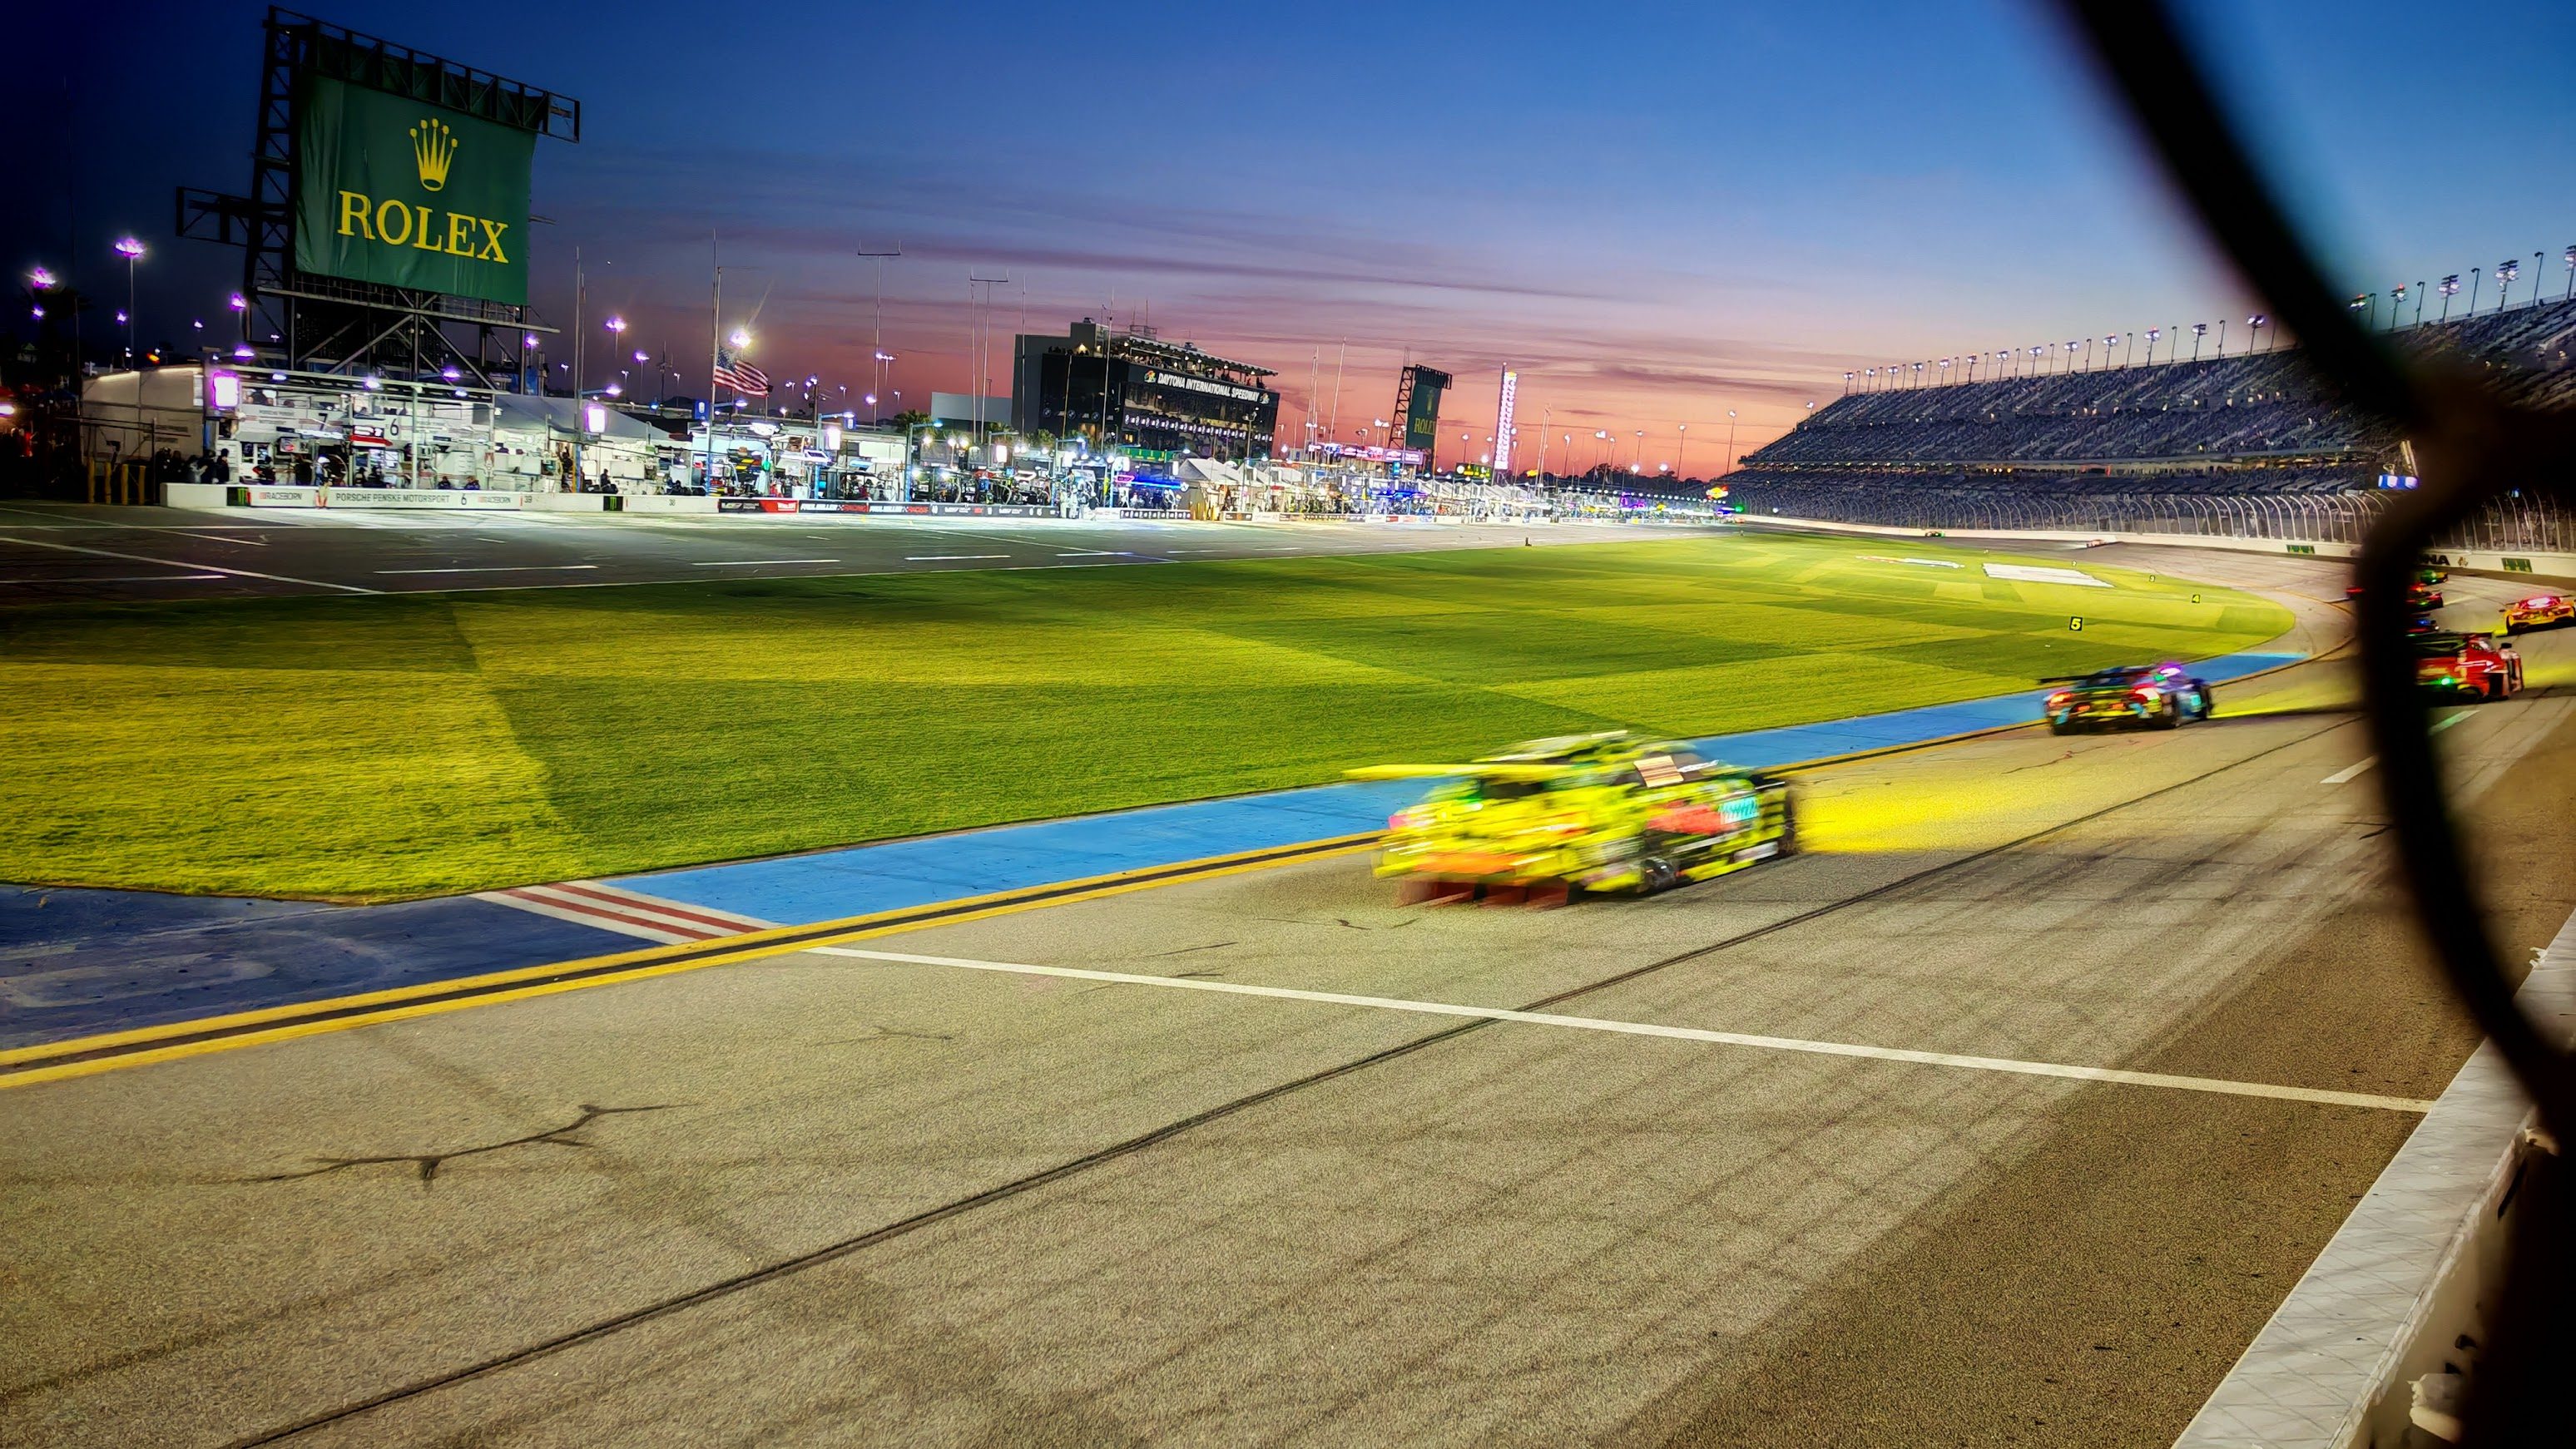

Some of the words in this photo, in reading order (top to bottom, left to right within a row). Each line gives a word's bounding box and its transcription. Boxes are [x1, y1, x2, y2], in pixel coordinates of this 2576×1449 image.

[337, 190, 509, 264] ROLEX
[1157, 372, 1186, 388] DAYTONA
[1186, 378, 1231, 397] INTERNATIONAL
[1231, 387, 1260, 403] SPEEDWAY
[390, 418, 399, 436] 6
[1414, 418, 1436, 436] ROLE
[335, 492, 371, 502] PORSCHE
[373, 493, 401, 502] PENSKE
[403, 494, 451, 504] MOTORSPORT
[461, 493, 468, 506] 6
[2192, 595, 2200, 603] 4
[2071, 618, 2082, 631] 5
